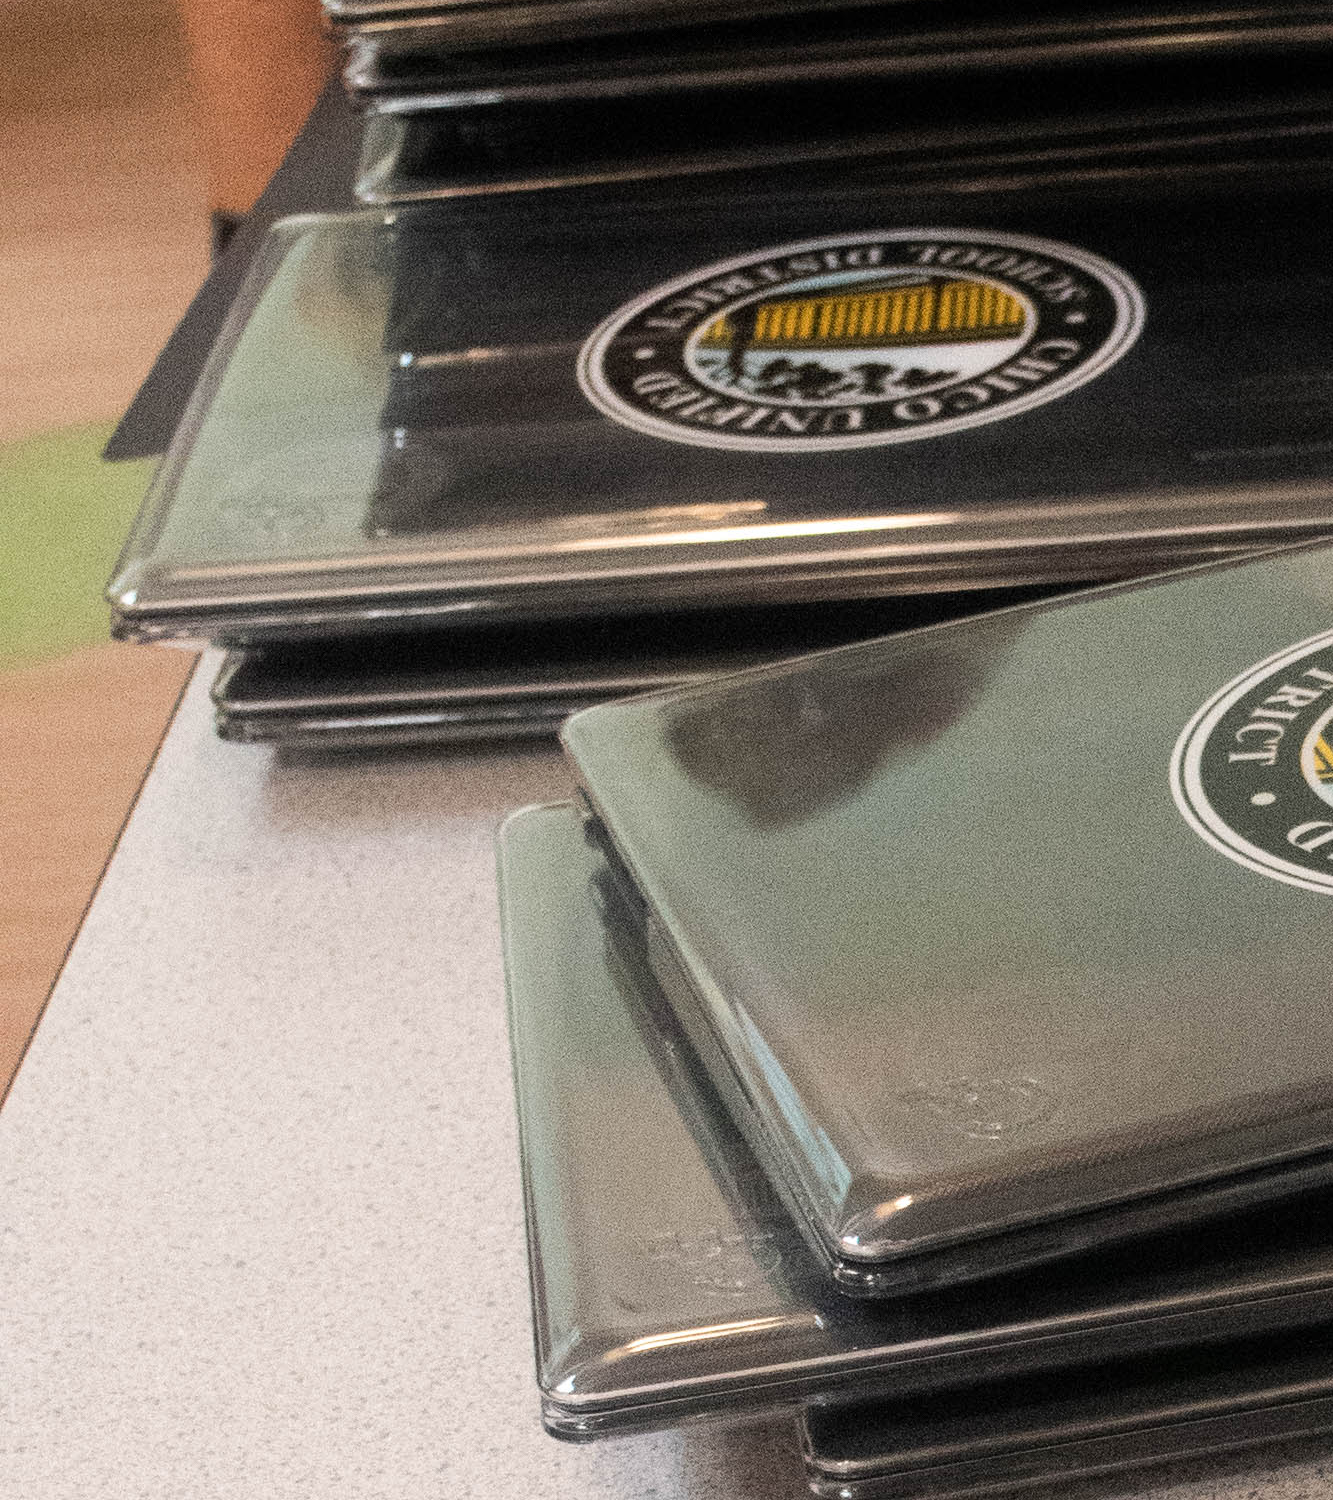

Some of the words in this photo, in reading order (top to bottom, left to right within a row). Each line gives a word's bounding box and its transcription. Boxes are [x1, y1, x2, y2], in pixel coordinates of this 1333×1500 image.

[645, 246, 883, 332] DISTRICT
[908, 245, 1089, 304] SCHOOL
[631, 370, 864, 435] UNIFIED
[894, 338, 1081, 422] CHICO
